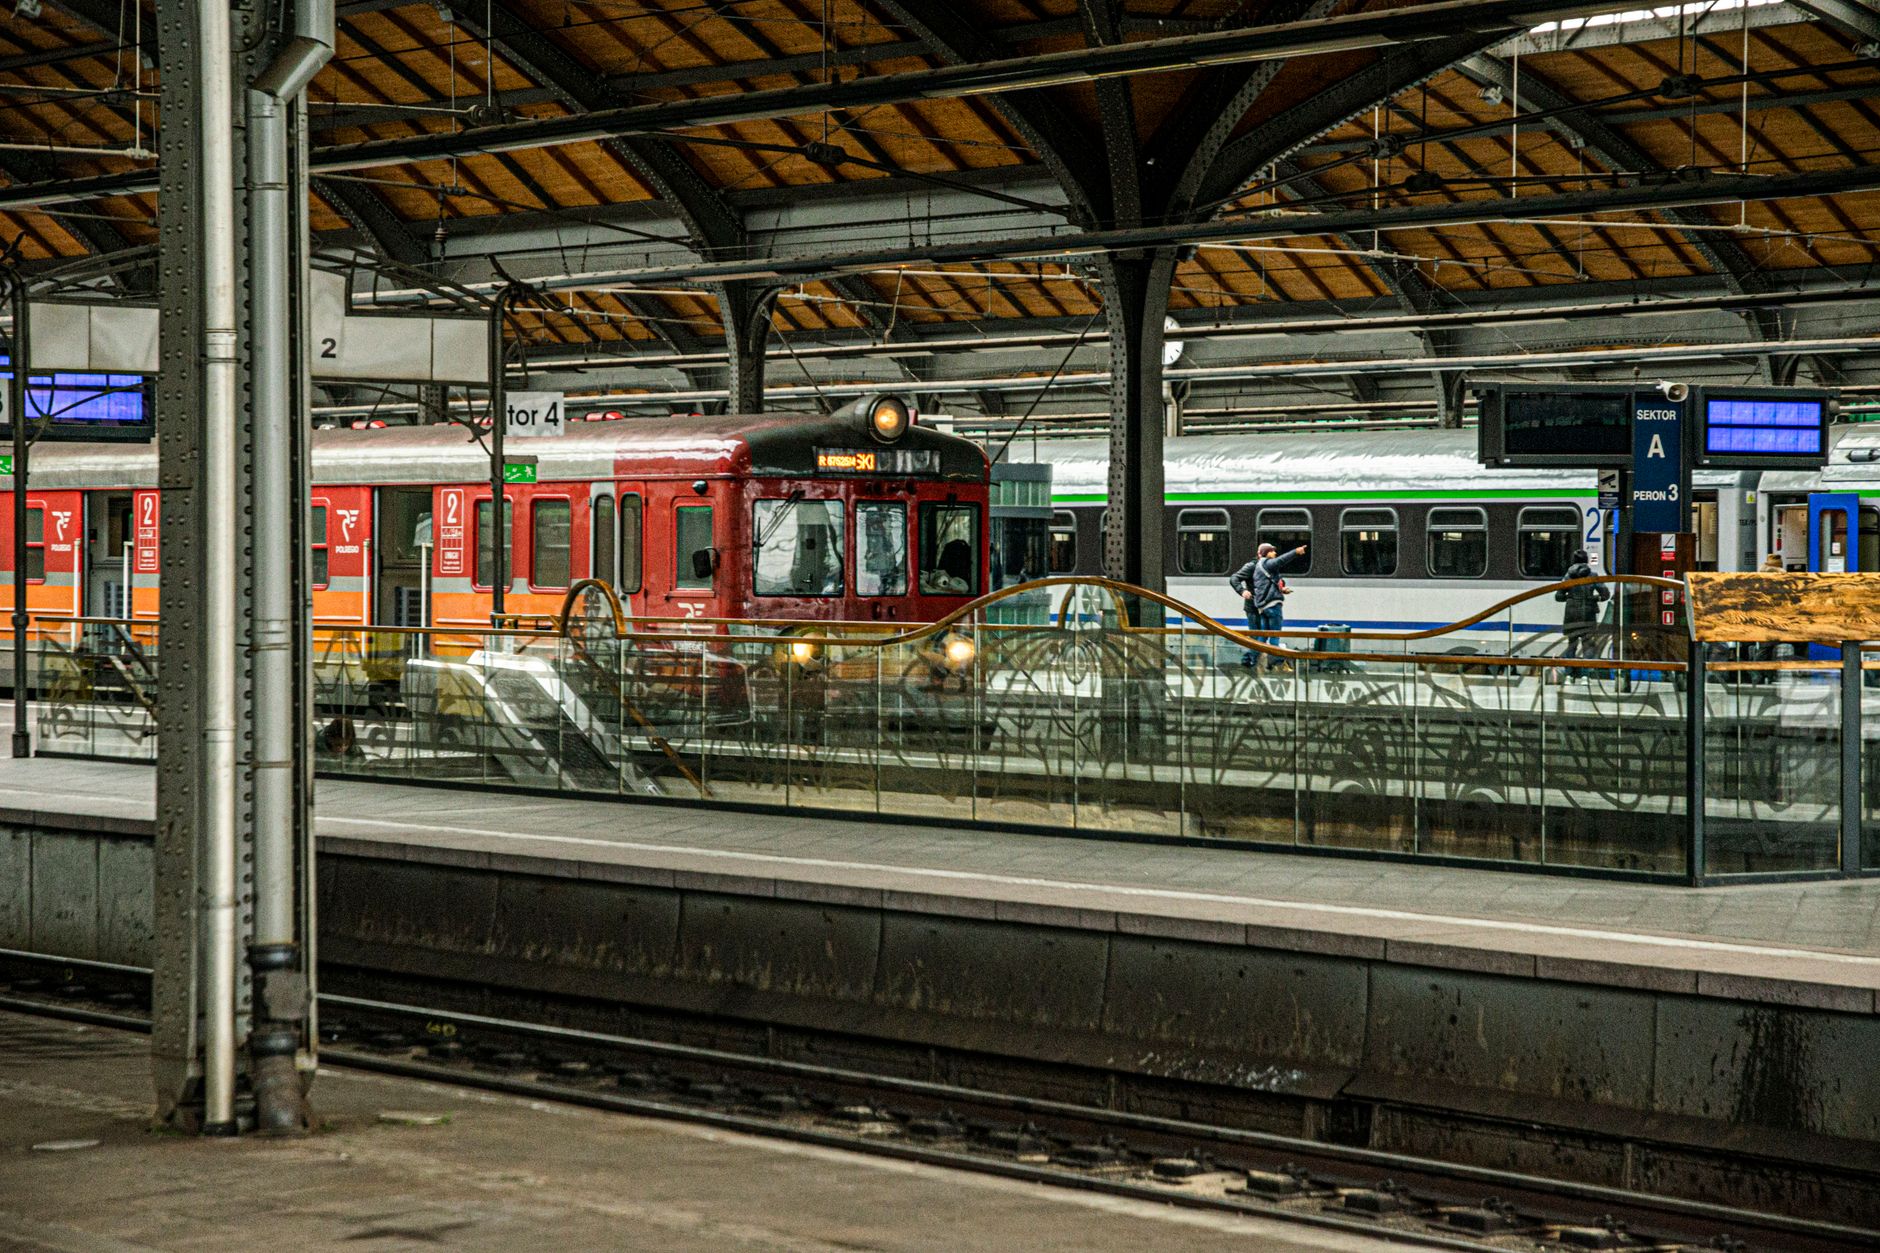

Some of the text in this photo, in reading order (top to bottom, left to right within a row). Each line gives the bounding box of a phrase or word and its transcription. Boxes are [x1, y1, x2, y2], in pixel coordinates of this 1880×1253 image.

[320, 337, 337, 359] 2
[507, 401, 560, 427] tor 4
[1636, 409, 1677, 421] SEKTOR
[1646, 433, 1666, 459] A
[1633, 490, 1667, 501] PERON
[1667, 483, 1679, 502] 3
[143, 496, 153, 525] 2
[446, 492, 458, 524] 2
[1585, 507, 1601, 543] 2
